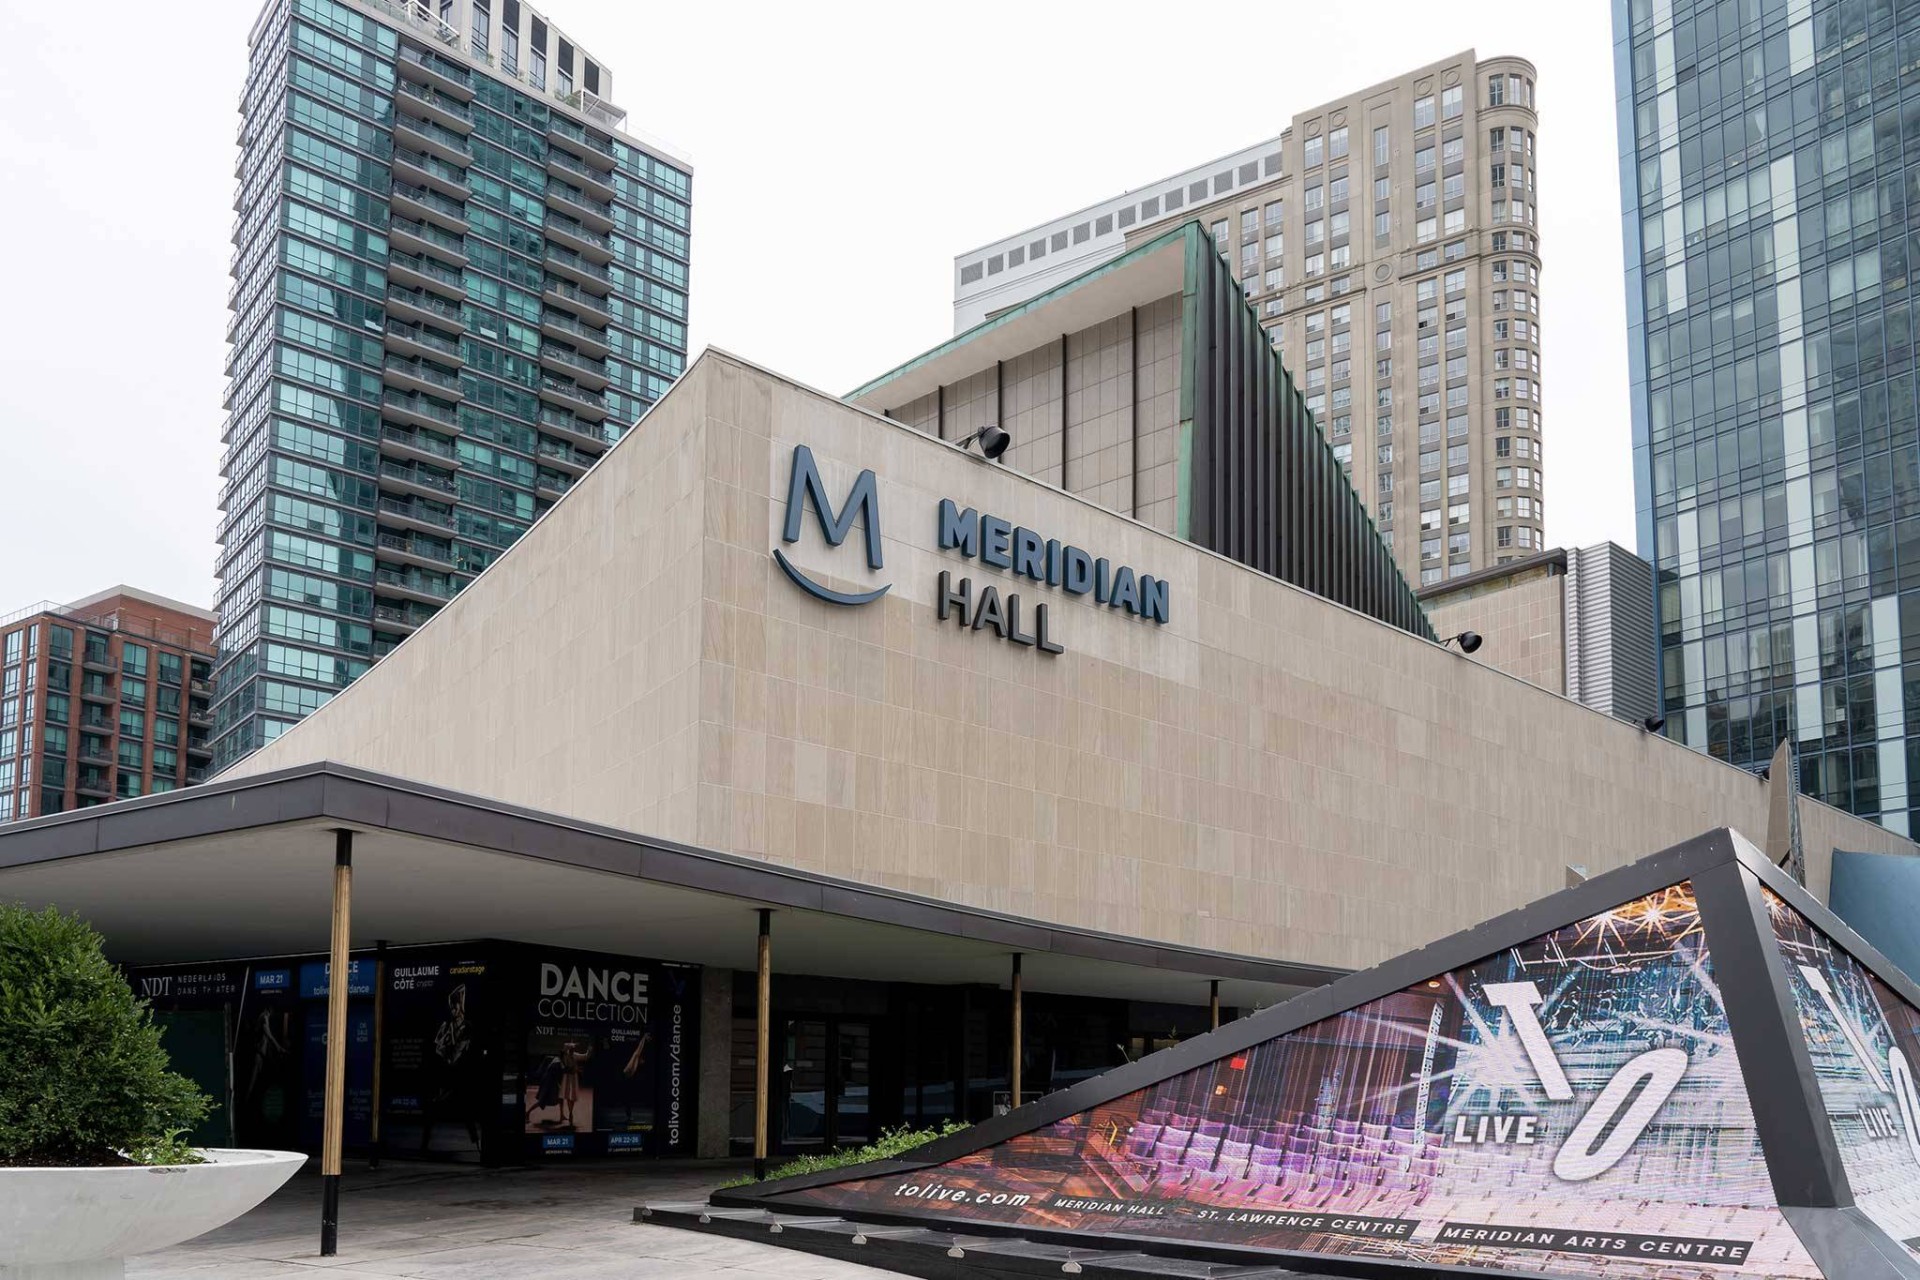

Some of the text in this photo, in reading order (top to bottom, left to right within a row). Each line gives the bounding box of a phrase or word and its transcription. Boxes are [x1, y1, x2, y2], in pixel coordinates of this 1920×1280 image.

[938, 497, 1170, 624] MERIDIAN
[937, 570, 1065, 656] HALL
[259, 973, 284, 985] MAR 21
[393, 965, 440, 978] GUILLAUME
[393, 977, 415, 990] CÔTÉ
[539, 962, 650, 1005] DANCE
[140, 975, 173, 998] NDT
[177, 986, 197, 996] DANS
[537, 997, 649, 1025] COLLECTION
[535, 1025, 555, 1036] NDT
[667, 1003, 683, 1146] tolive.com/dance
[1453, 1115, 1540, 1145] LIVE
[1858, 1106, 1898, 1139] LIVE
[546, 1137, 569, 1146] MAR 21
[610, 1136, 622, 1145] APR
[894, 1183, 1031, 1207] tolive.com
[1054, 1198, 1165, 1216] MERIDIAN HALL
[1197, 1208, 1409, 1235] ST. LAWRENCE CENTRE
[1443, 1226, 1746, 1259] MERIDIAN ARTS CENTRE
